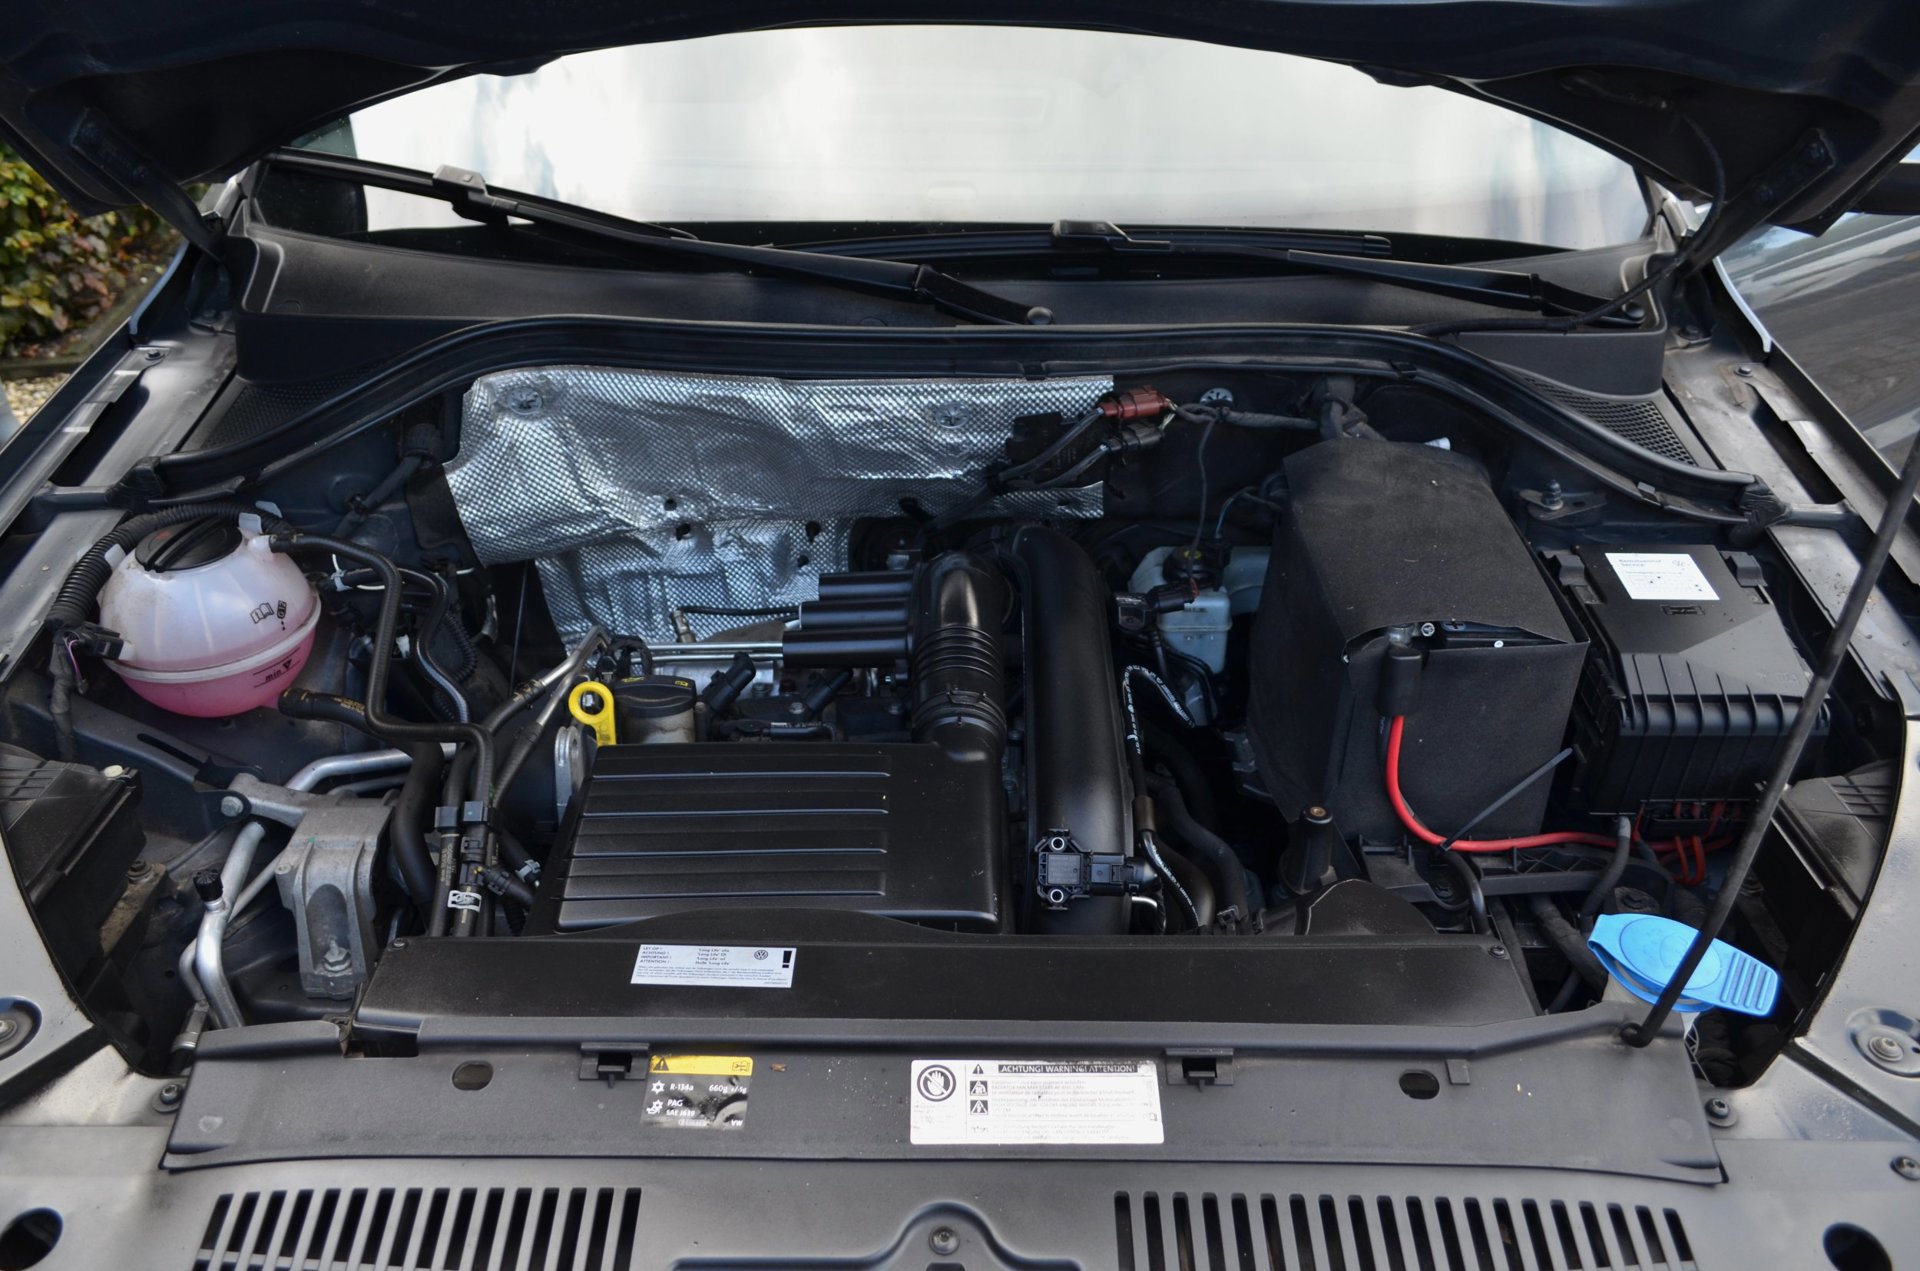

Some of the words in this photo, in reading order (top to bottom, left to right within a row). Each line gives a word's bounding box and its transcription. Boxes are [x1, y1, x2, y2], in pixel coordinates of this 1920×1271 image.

[265, 670, 281, 682] min
[1001, 1065, 1044, 1073] ACHTUNG!
[1045, 1065, 1087, 1073] WARNING!
[669, 1083, 694, 1091] R-134a
[709, 1084, 728, 1094] 660g
[667, 1098, 684, 1107] PAG
[731, 1119, 744, 1127] VW
